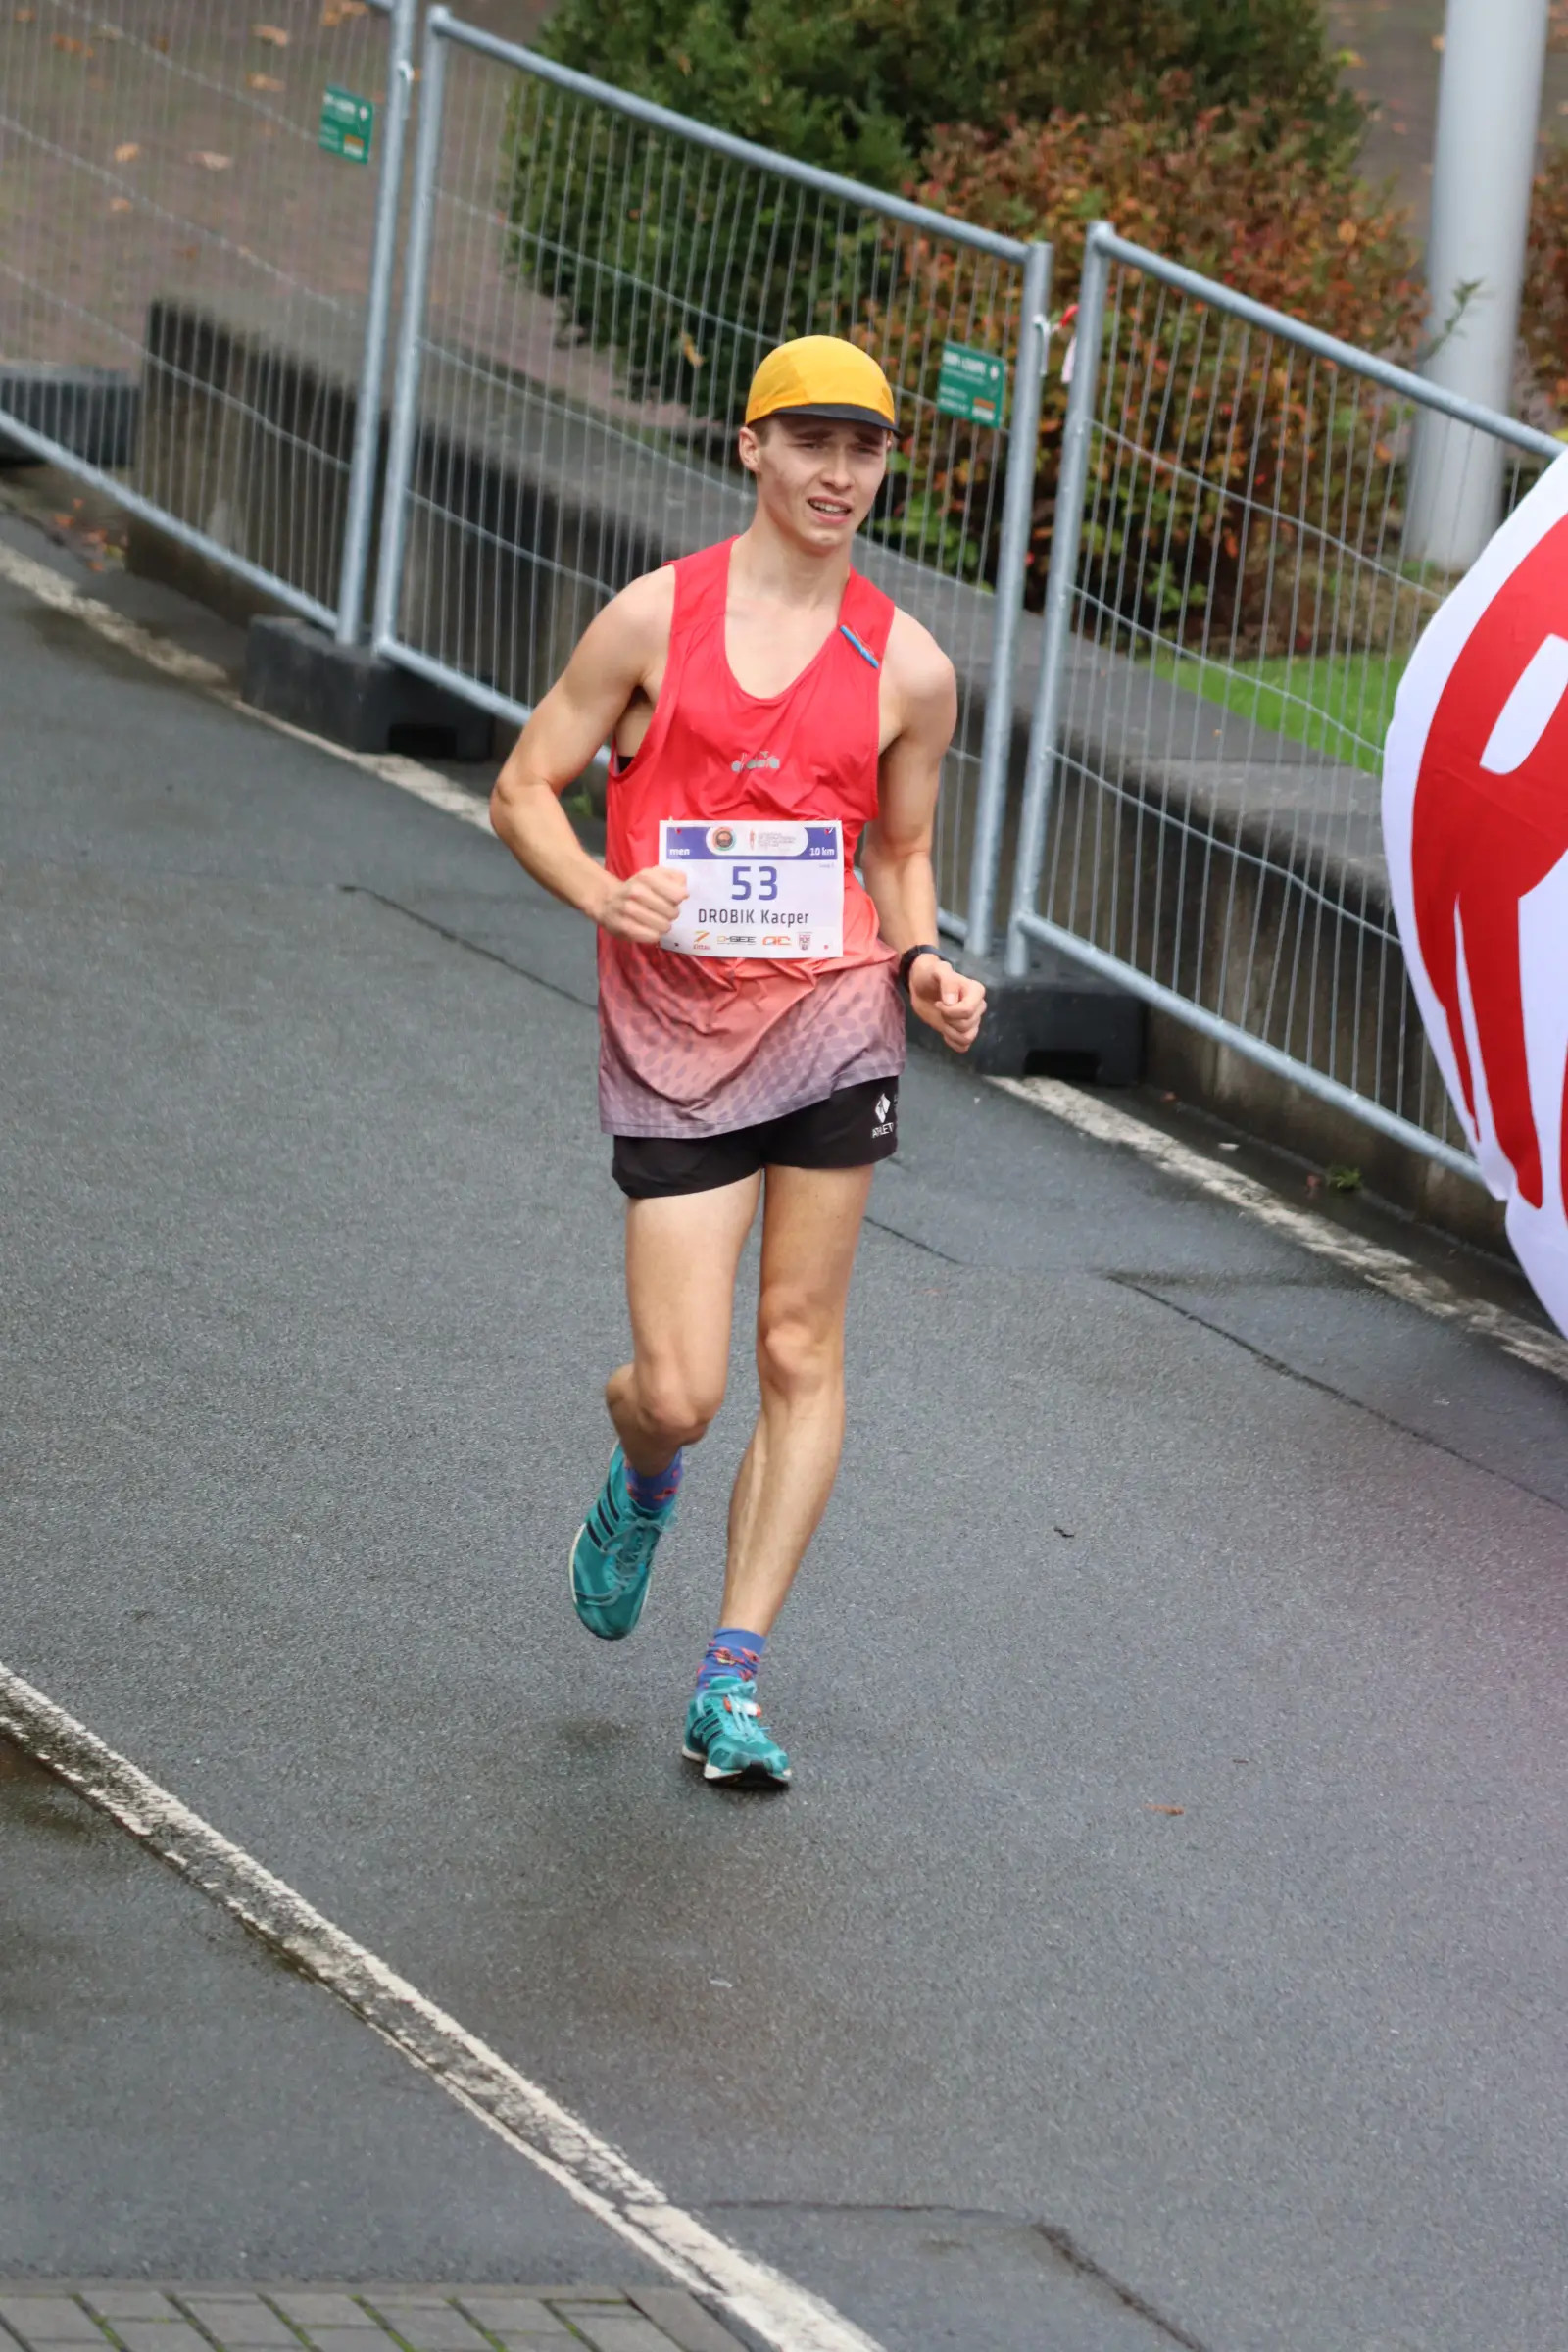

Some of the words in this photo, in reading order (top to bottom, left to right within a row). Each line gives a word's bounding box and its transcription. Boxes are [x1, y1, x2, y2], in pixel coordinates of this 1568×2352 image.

[809, 847, 820, 856] 10
[821, 847, 835, 856] km
[731, 866, 778, 901] 53
[698, 908, 755, 924] DROBIK
[760, 909, 809, 928] Kacper
